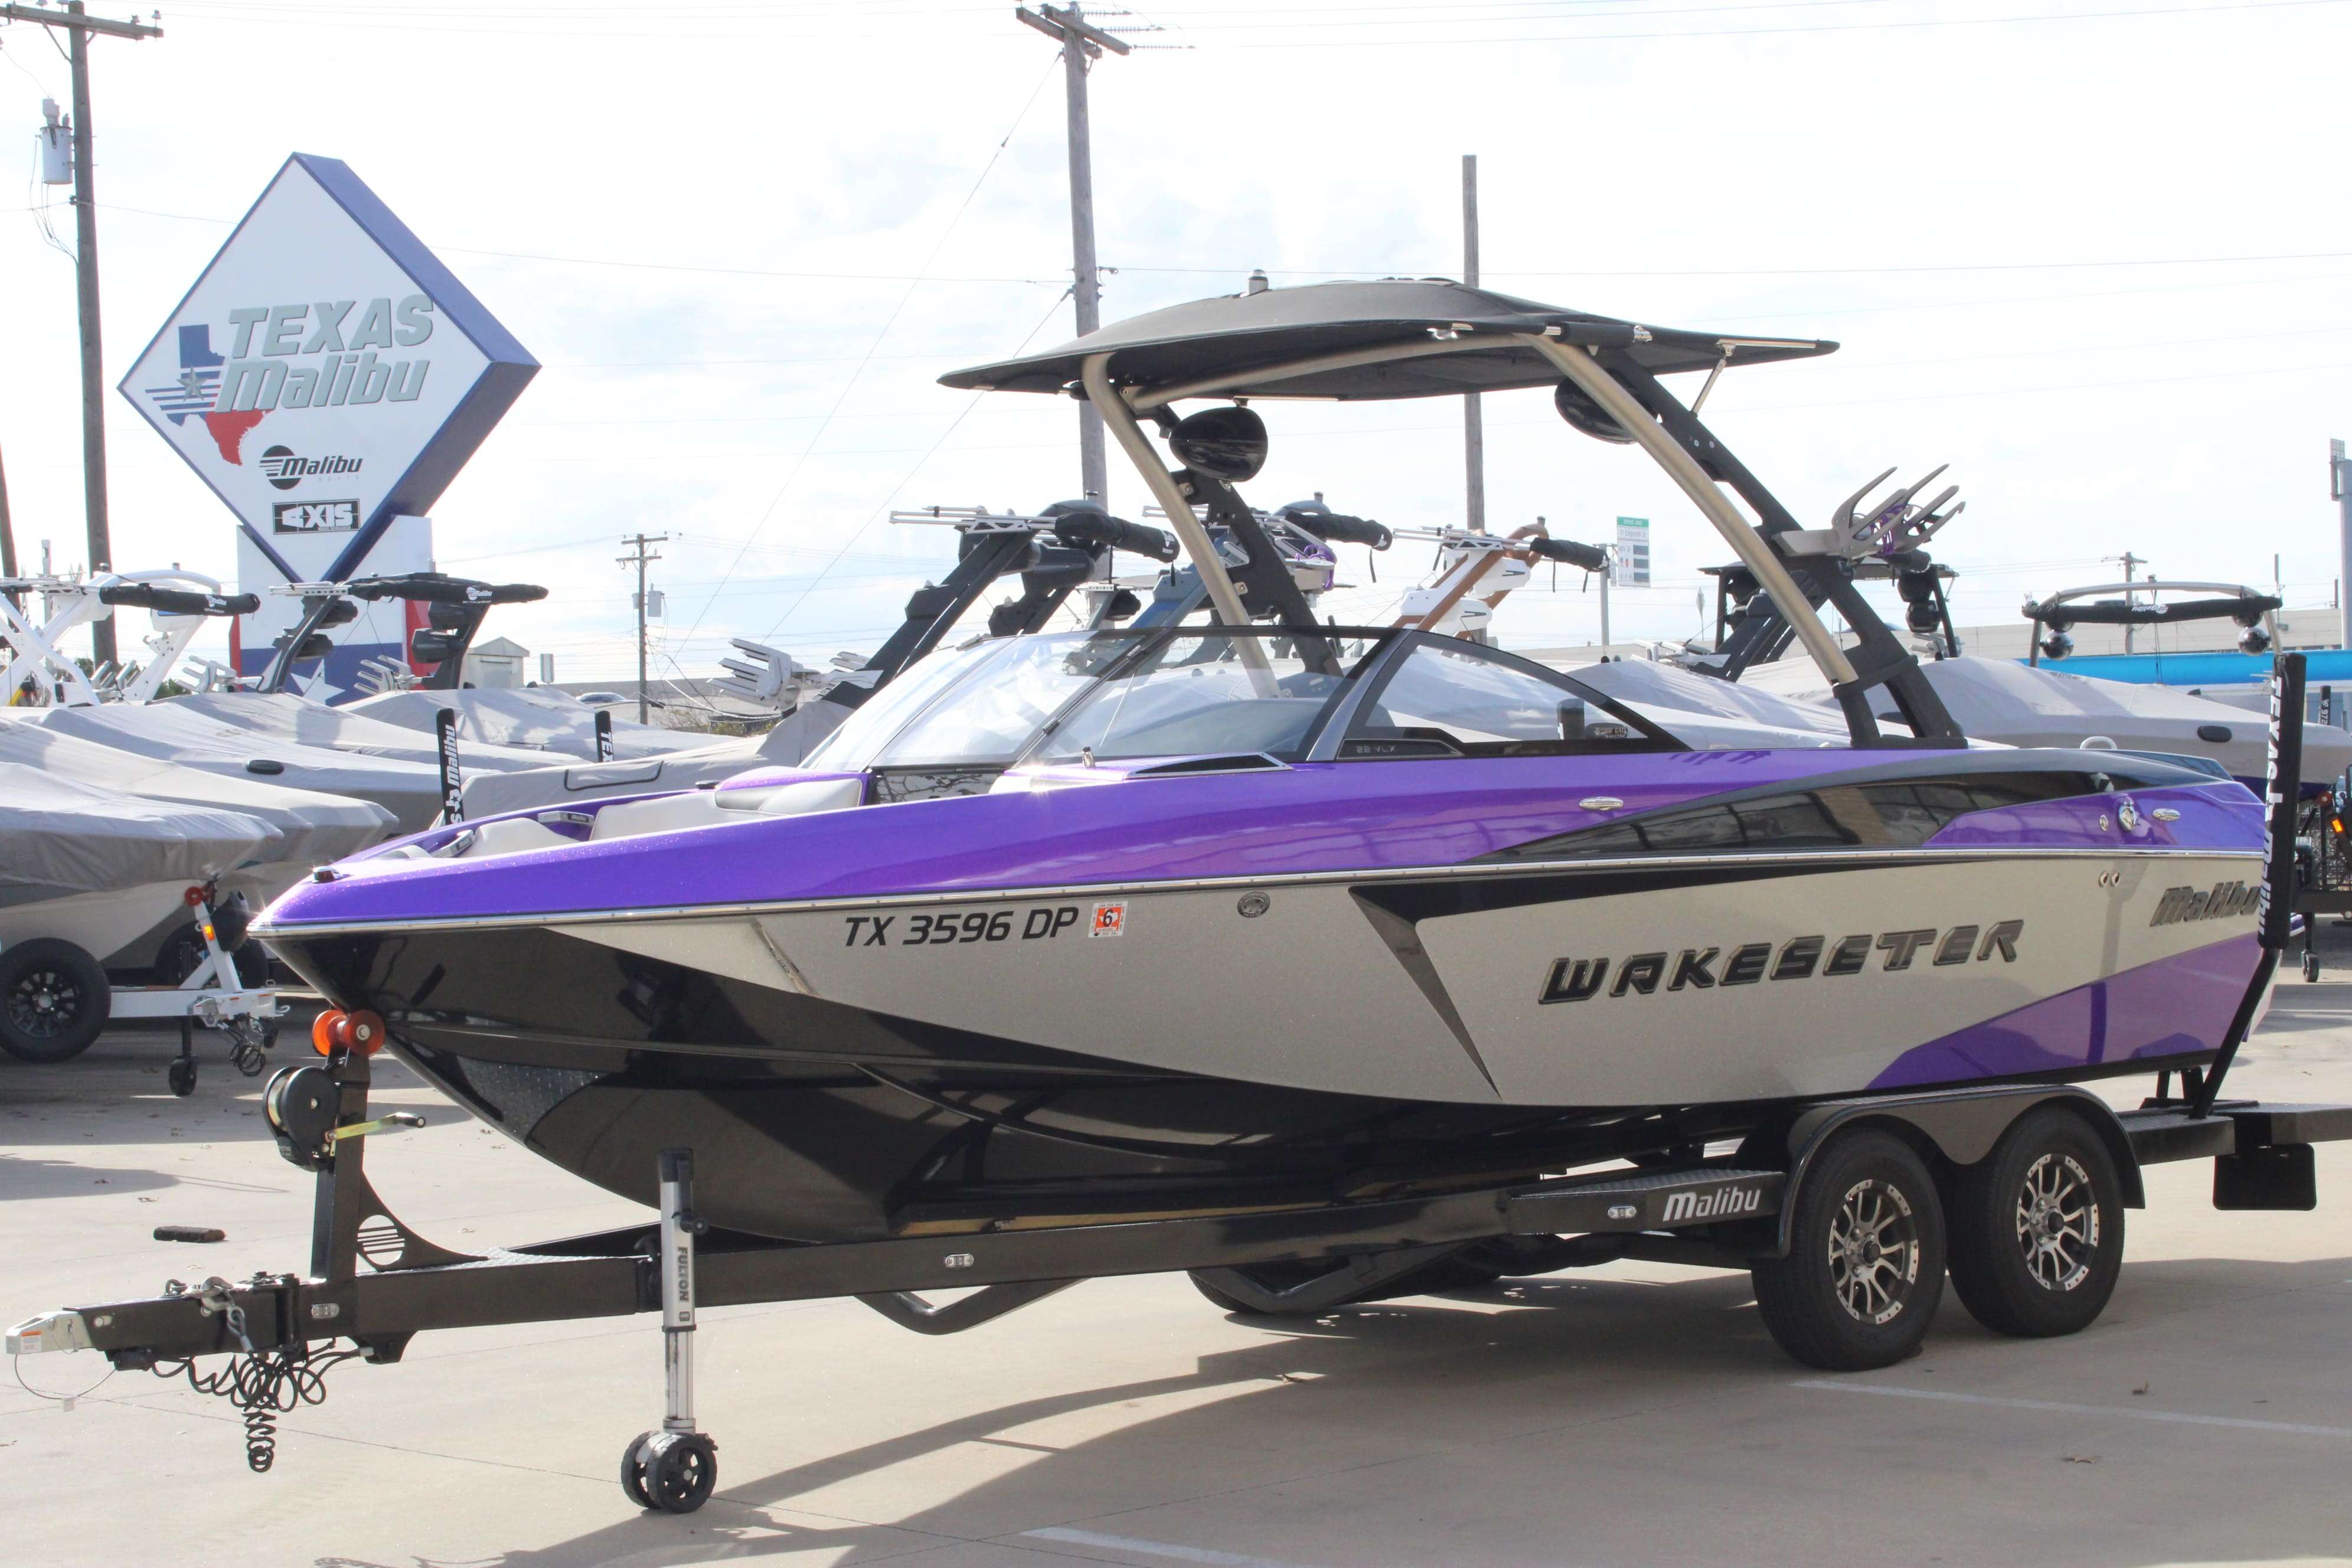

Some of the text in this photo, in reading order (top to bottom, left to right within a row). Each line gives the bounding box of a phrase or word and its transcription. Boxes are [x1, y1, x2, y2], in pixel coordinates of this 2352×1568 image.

[228, 294, 434, 359] TEXAS
[214, 352, 430, 413] Malibu
[280, 455, 364, 476] Malibu
[282, 504, 354, 529] AXIS
[2266, 676, 2282, 779] TEXAS
[444, 724, 460, 788] Malibu
[845, 916, 896, 946] TX
[902, 911, 1014, 945] 3596
[1022, 906, 1079, 940] DP
[1103, 909, 1113, 927] 6
[2150, 880, 2260, 927] Malibu
[1538, 919, 2024, 1005] WAKESETTER
[1662, 1185, 1761, 1221] Malibu
[678, 1247, 690, 1301] FULTON
